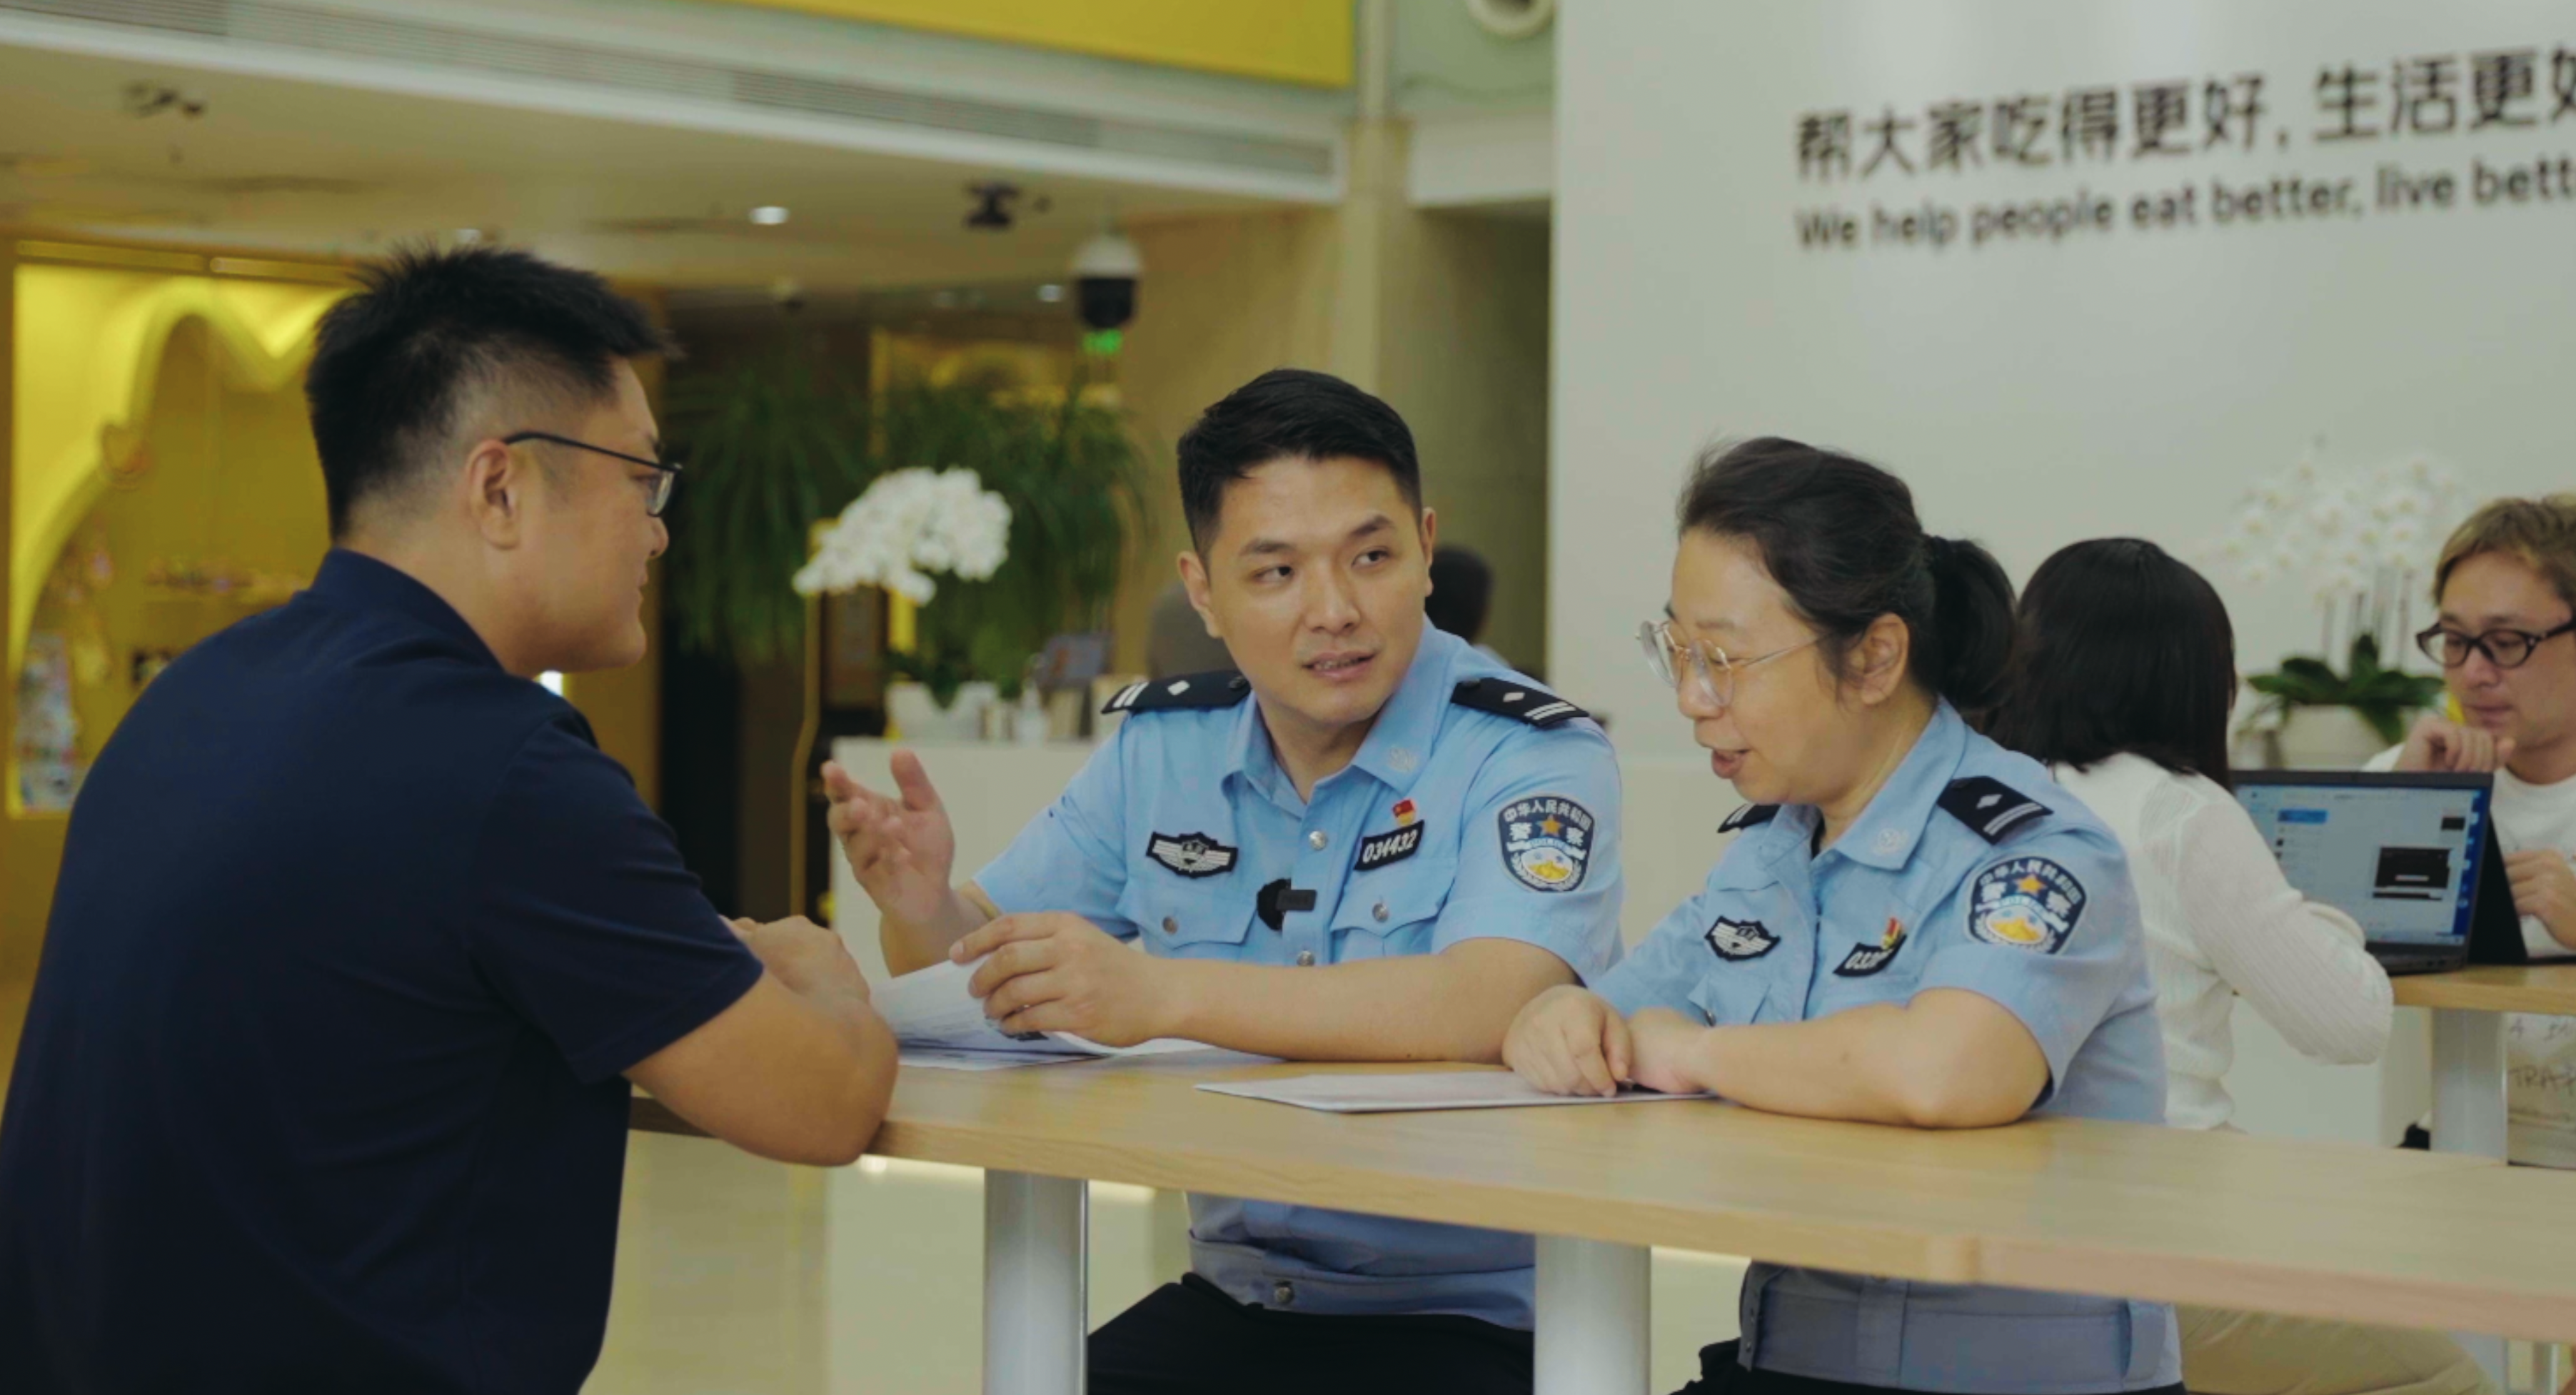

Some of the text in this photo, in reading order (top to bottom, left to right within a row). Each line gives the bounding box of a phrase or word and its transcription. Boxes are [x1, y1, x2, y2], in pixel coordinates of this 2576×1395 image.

[1795, 208, 1858, 248] We
[1870, 199, 1959, 249] help
[1970, 188, 2113, 246] people
[2132, 183, 2195, 228] eat
[2375, 163, 2455, 208] live
[1362, 829, 1418, 864] 034432
